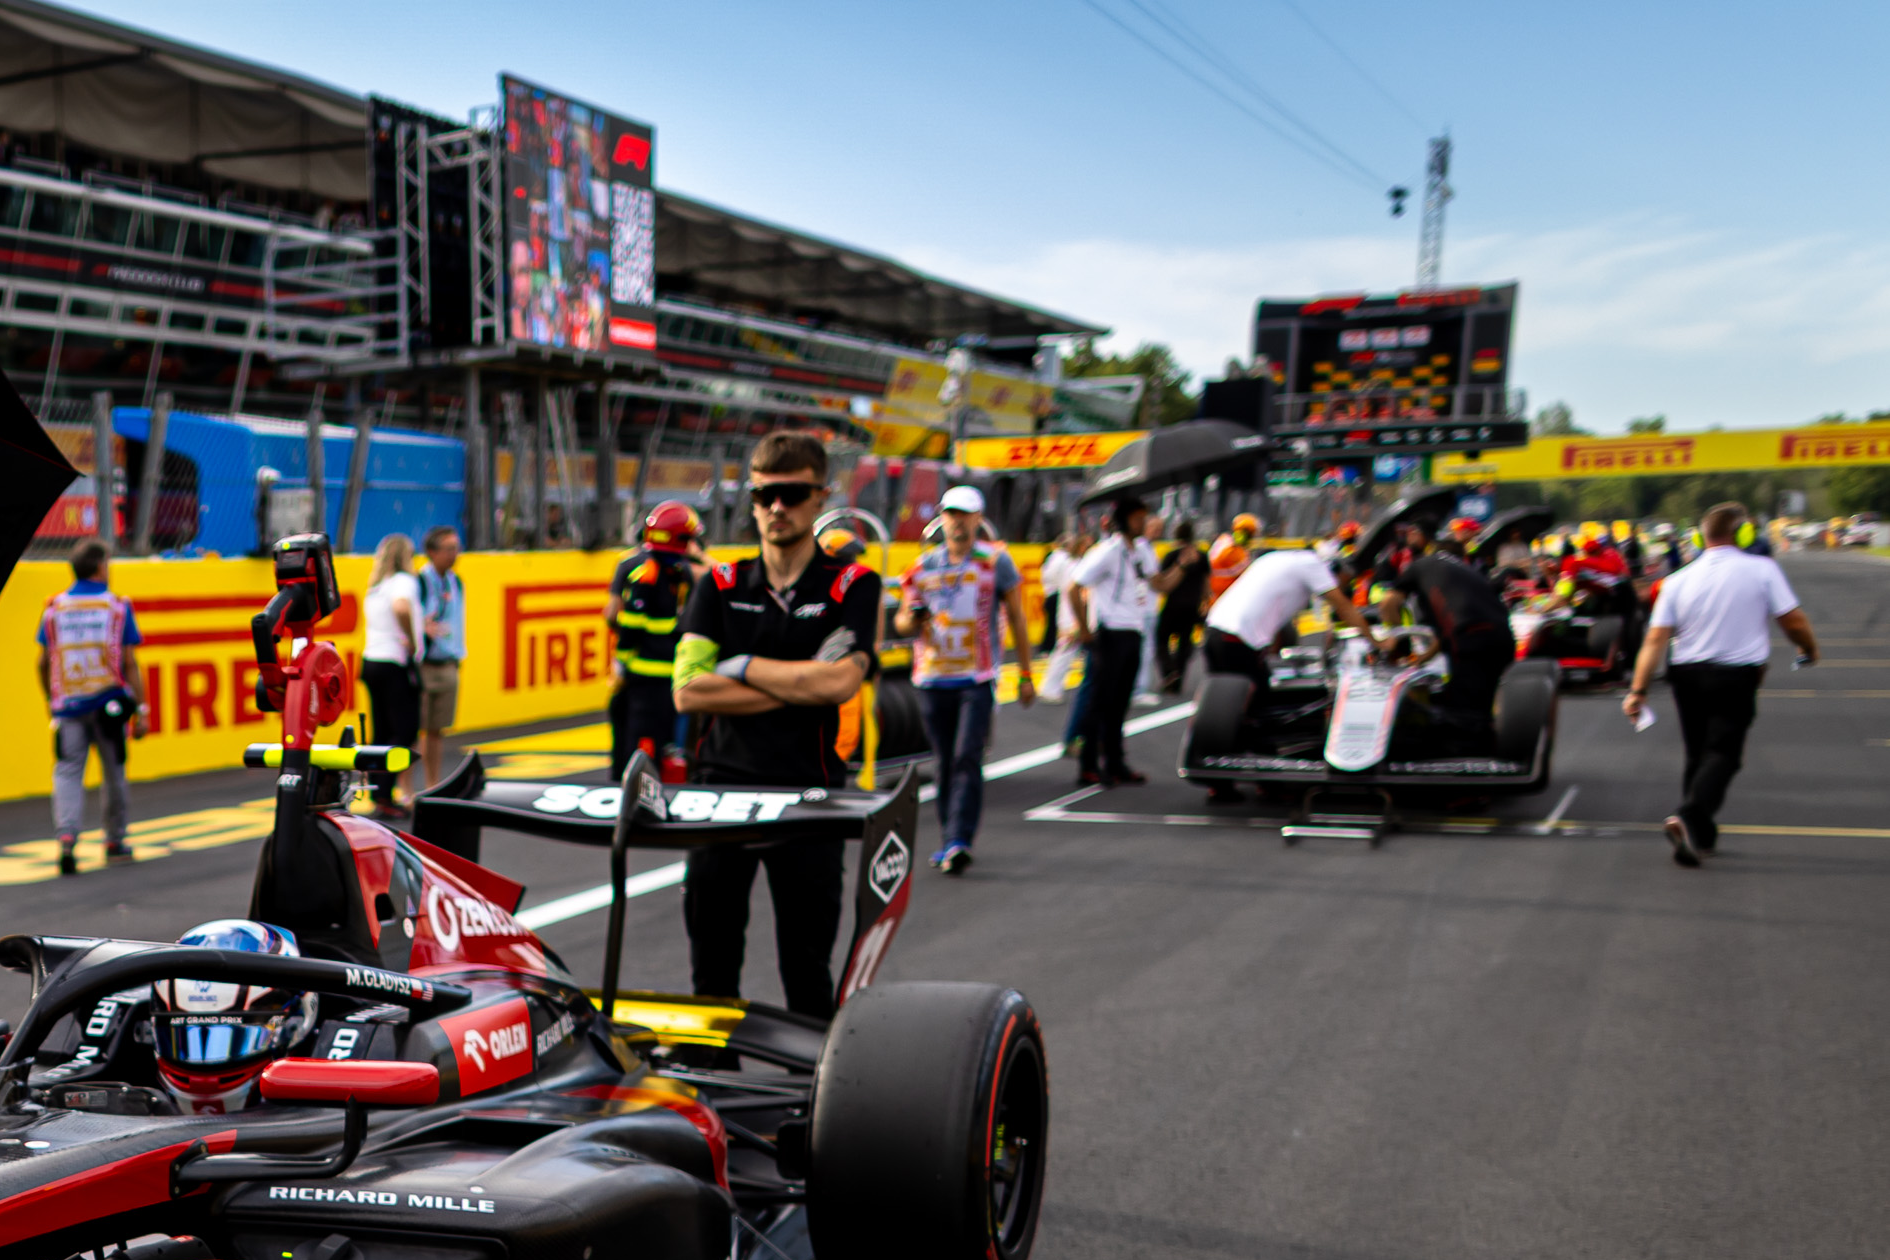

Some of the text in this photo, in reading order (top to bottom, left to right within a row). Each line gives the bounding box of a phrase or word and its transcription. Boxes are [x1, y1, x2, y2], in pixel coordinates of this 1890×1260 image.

[532, 784, 802, 823] SOBET
[346, 968, 412, 995] M.GLADYSZ
[187, 1016, 218, 1024] GRAND
[220, 1016, 242, 1024] PRIX
[489, 1021, 528, 1061] ORLEN
[269, 1186, 496, 1214] RICHARD MILLE
